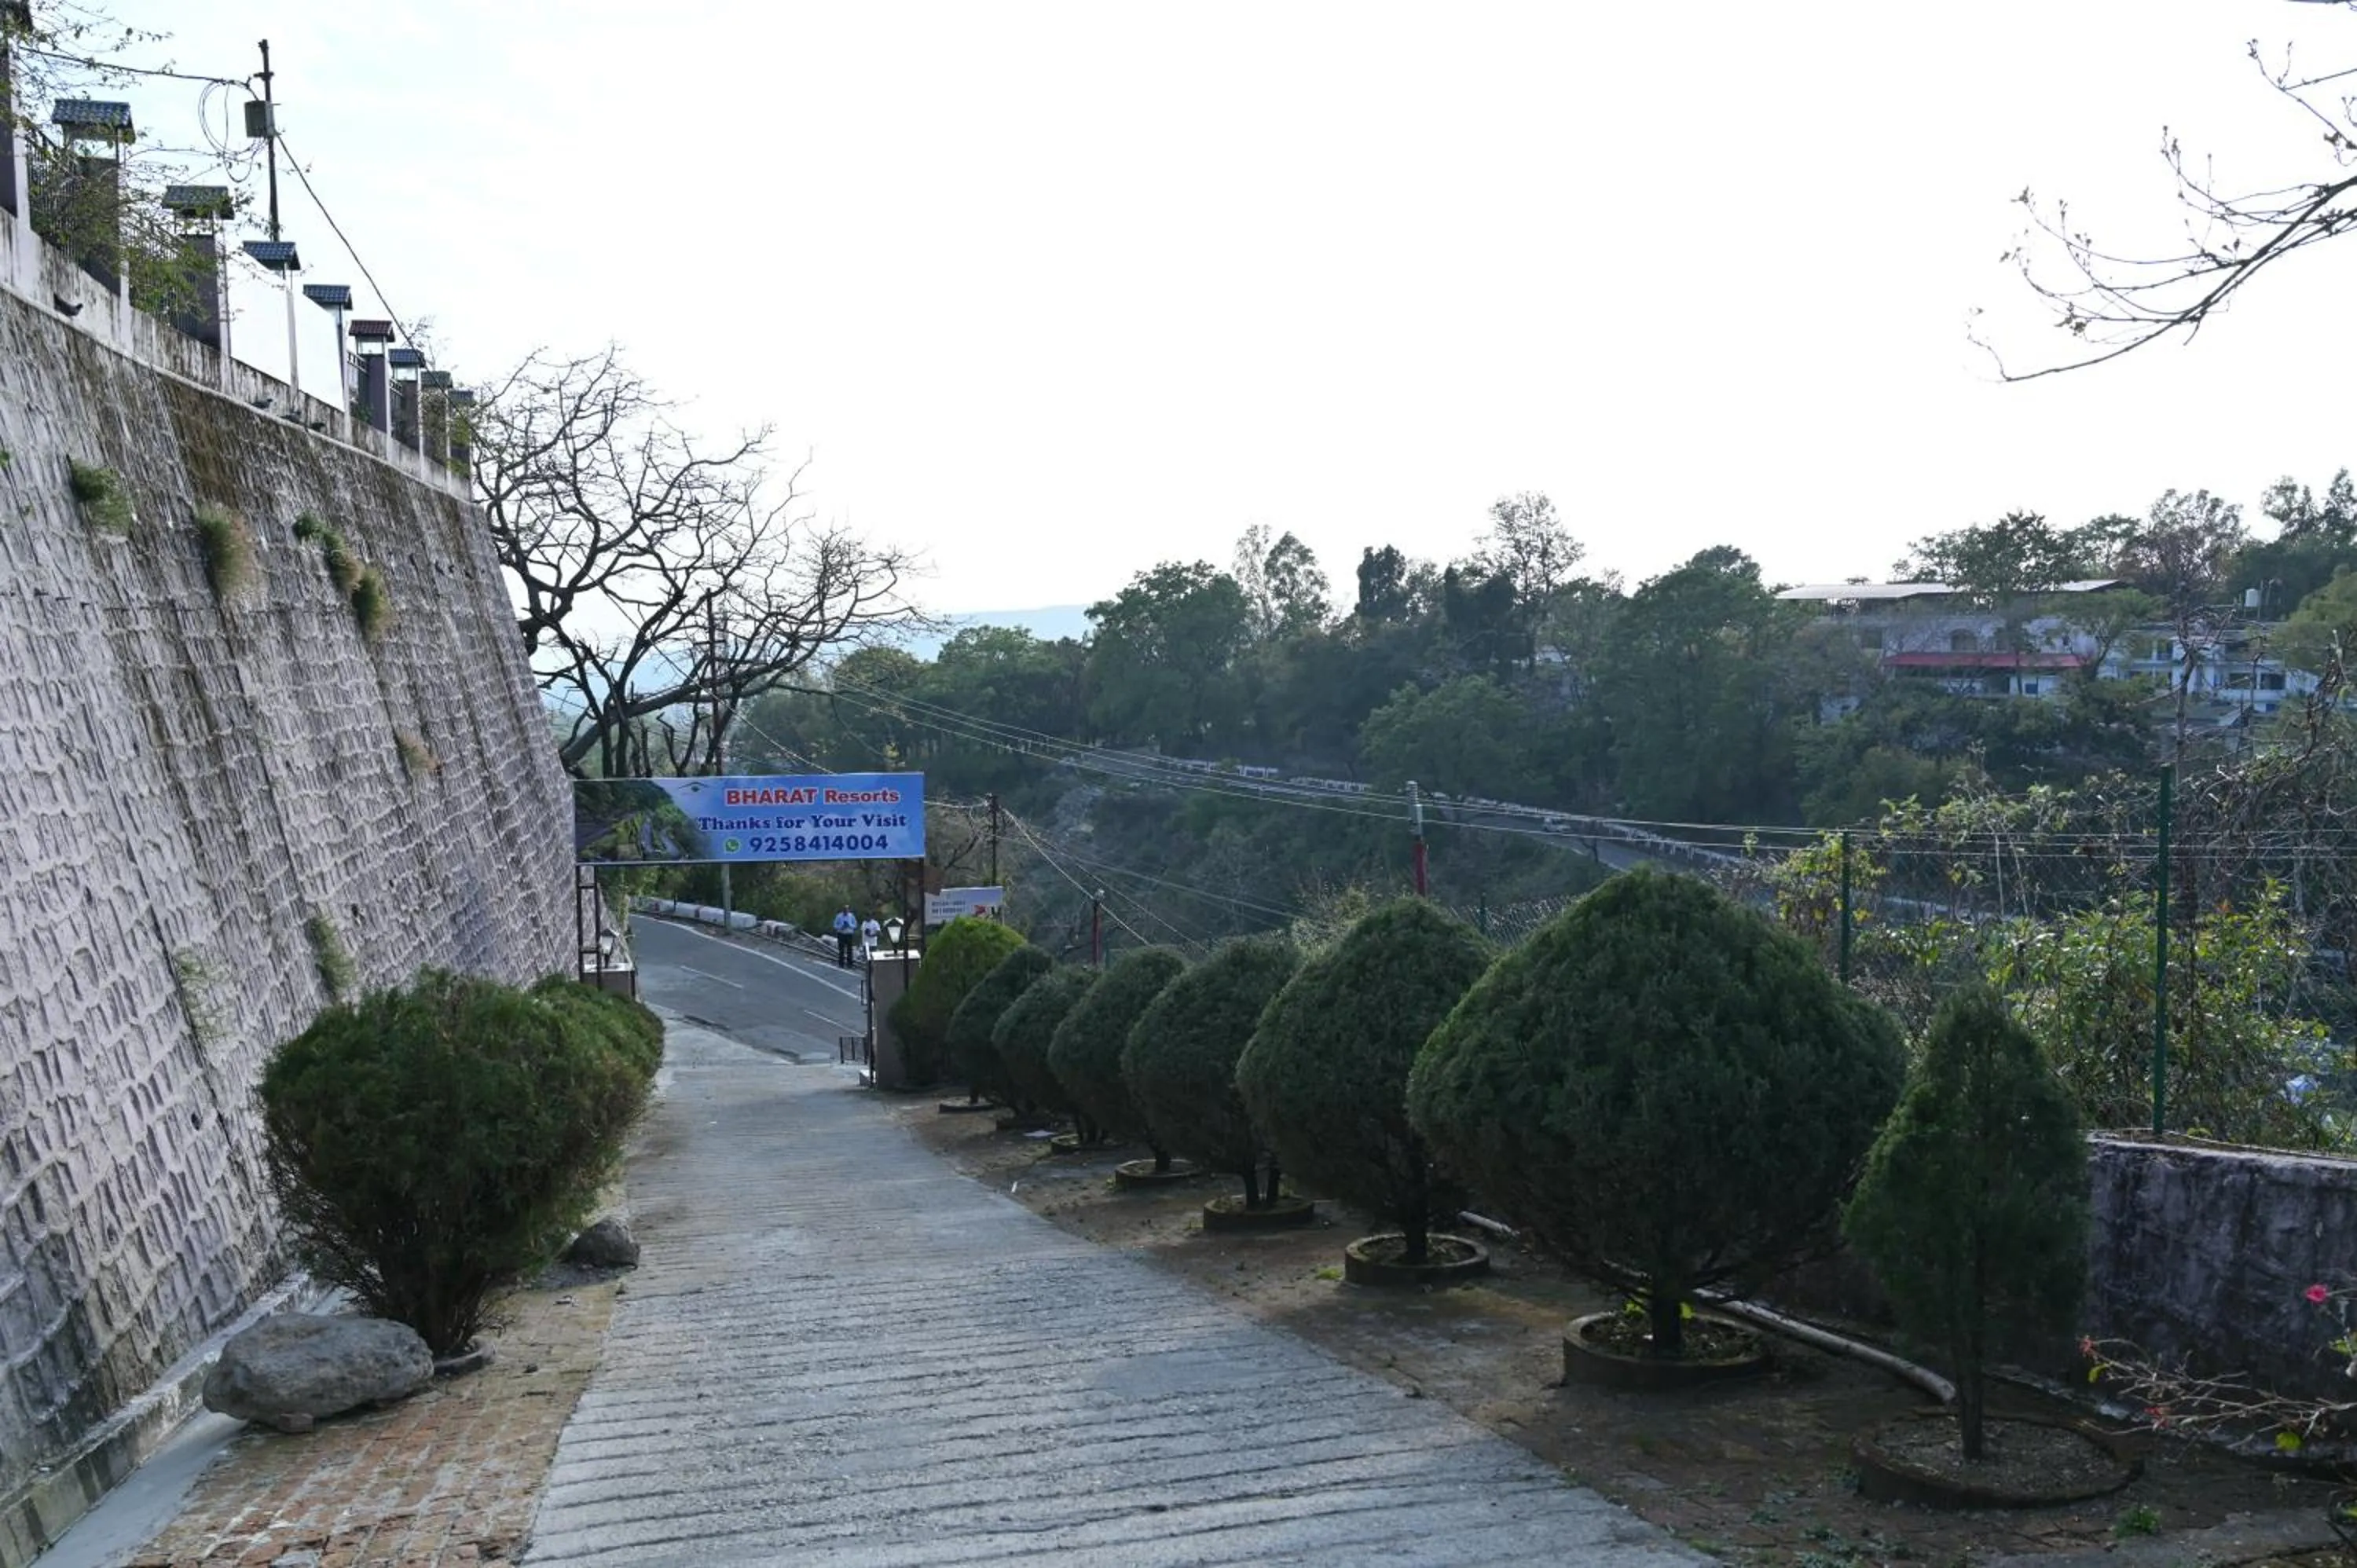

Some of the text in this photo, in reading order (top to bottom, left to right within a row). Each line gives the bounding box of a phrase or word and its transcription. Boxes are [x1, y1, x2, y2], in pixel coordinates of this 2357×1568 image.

[726, 789, 900, 805] BHARAT Resorts
[698, 814, 907, 830] Thanks for Your Visit
[750, 835, 889, 852] 9258414004
